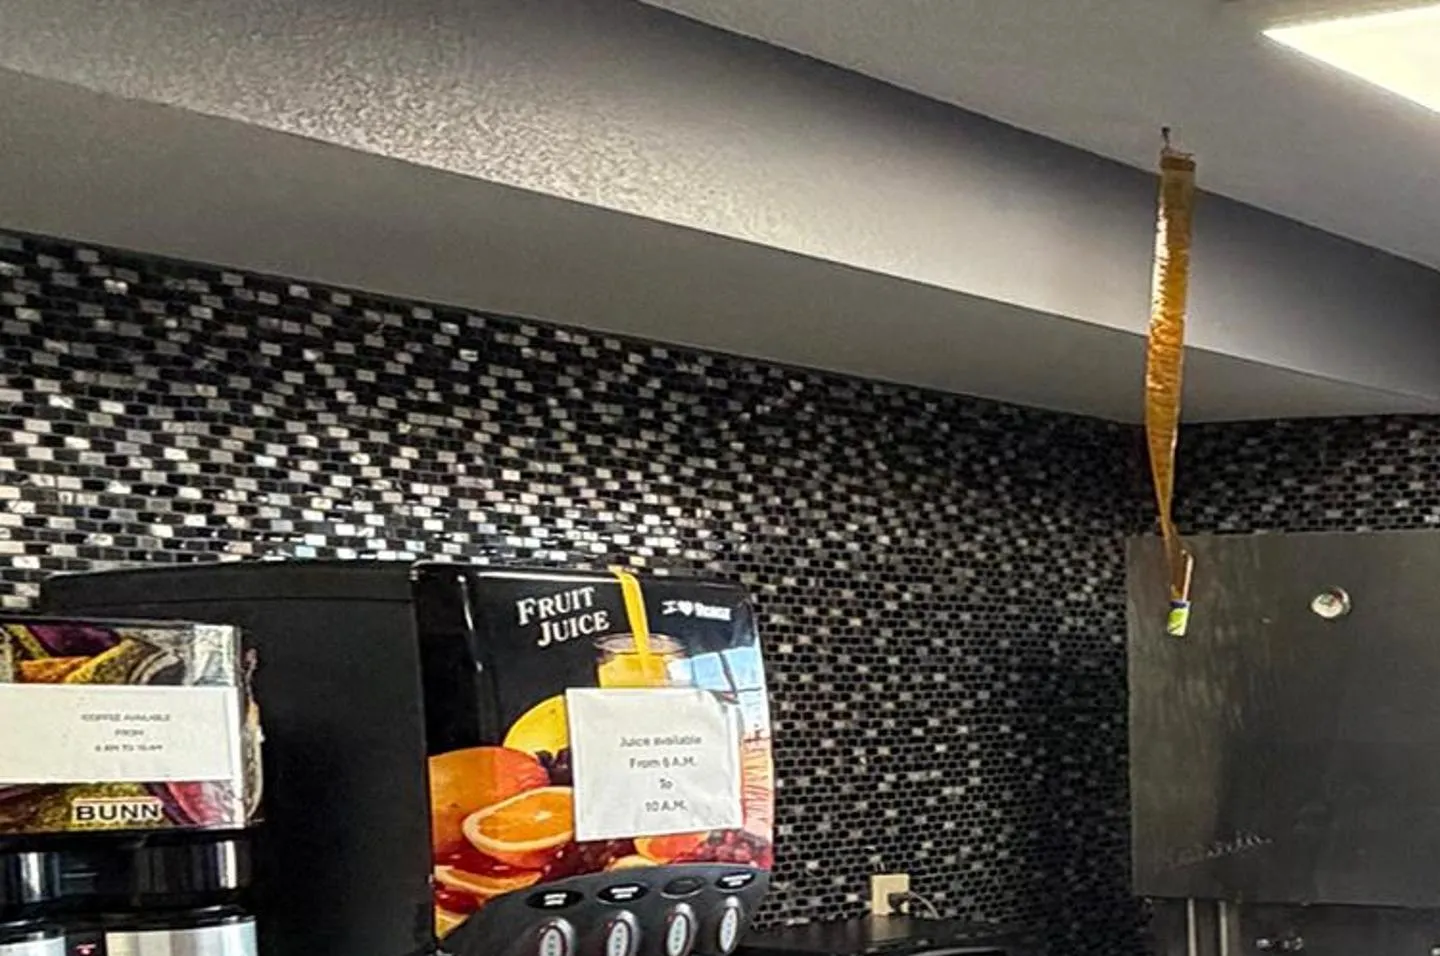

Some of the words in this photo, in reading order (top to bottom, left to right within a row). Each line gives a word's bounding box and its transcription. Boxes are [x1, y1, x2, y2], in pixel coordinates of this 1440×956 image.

[516, 586, 595, 626] FRUIT
[537, 610, 610, 647] JUICE
[620, 737, 650, 747] Juice
[654, 735, 702, 746] available
[629, 757, 660, 768] From
[76, 804, 160, 821] BUNN
